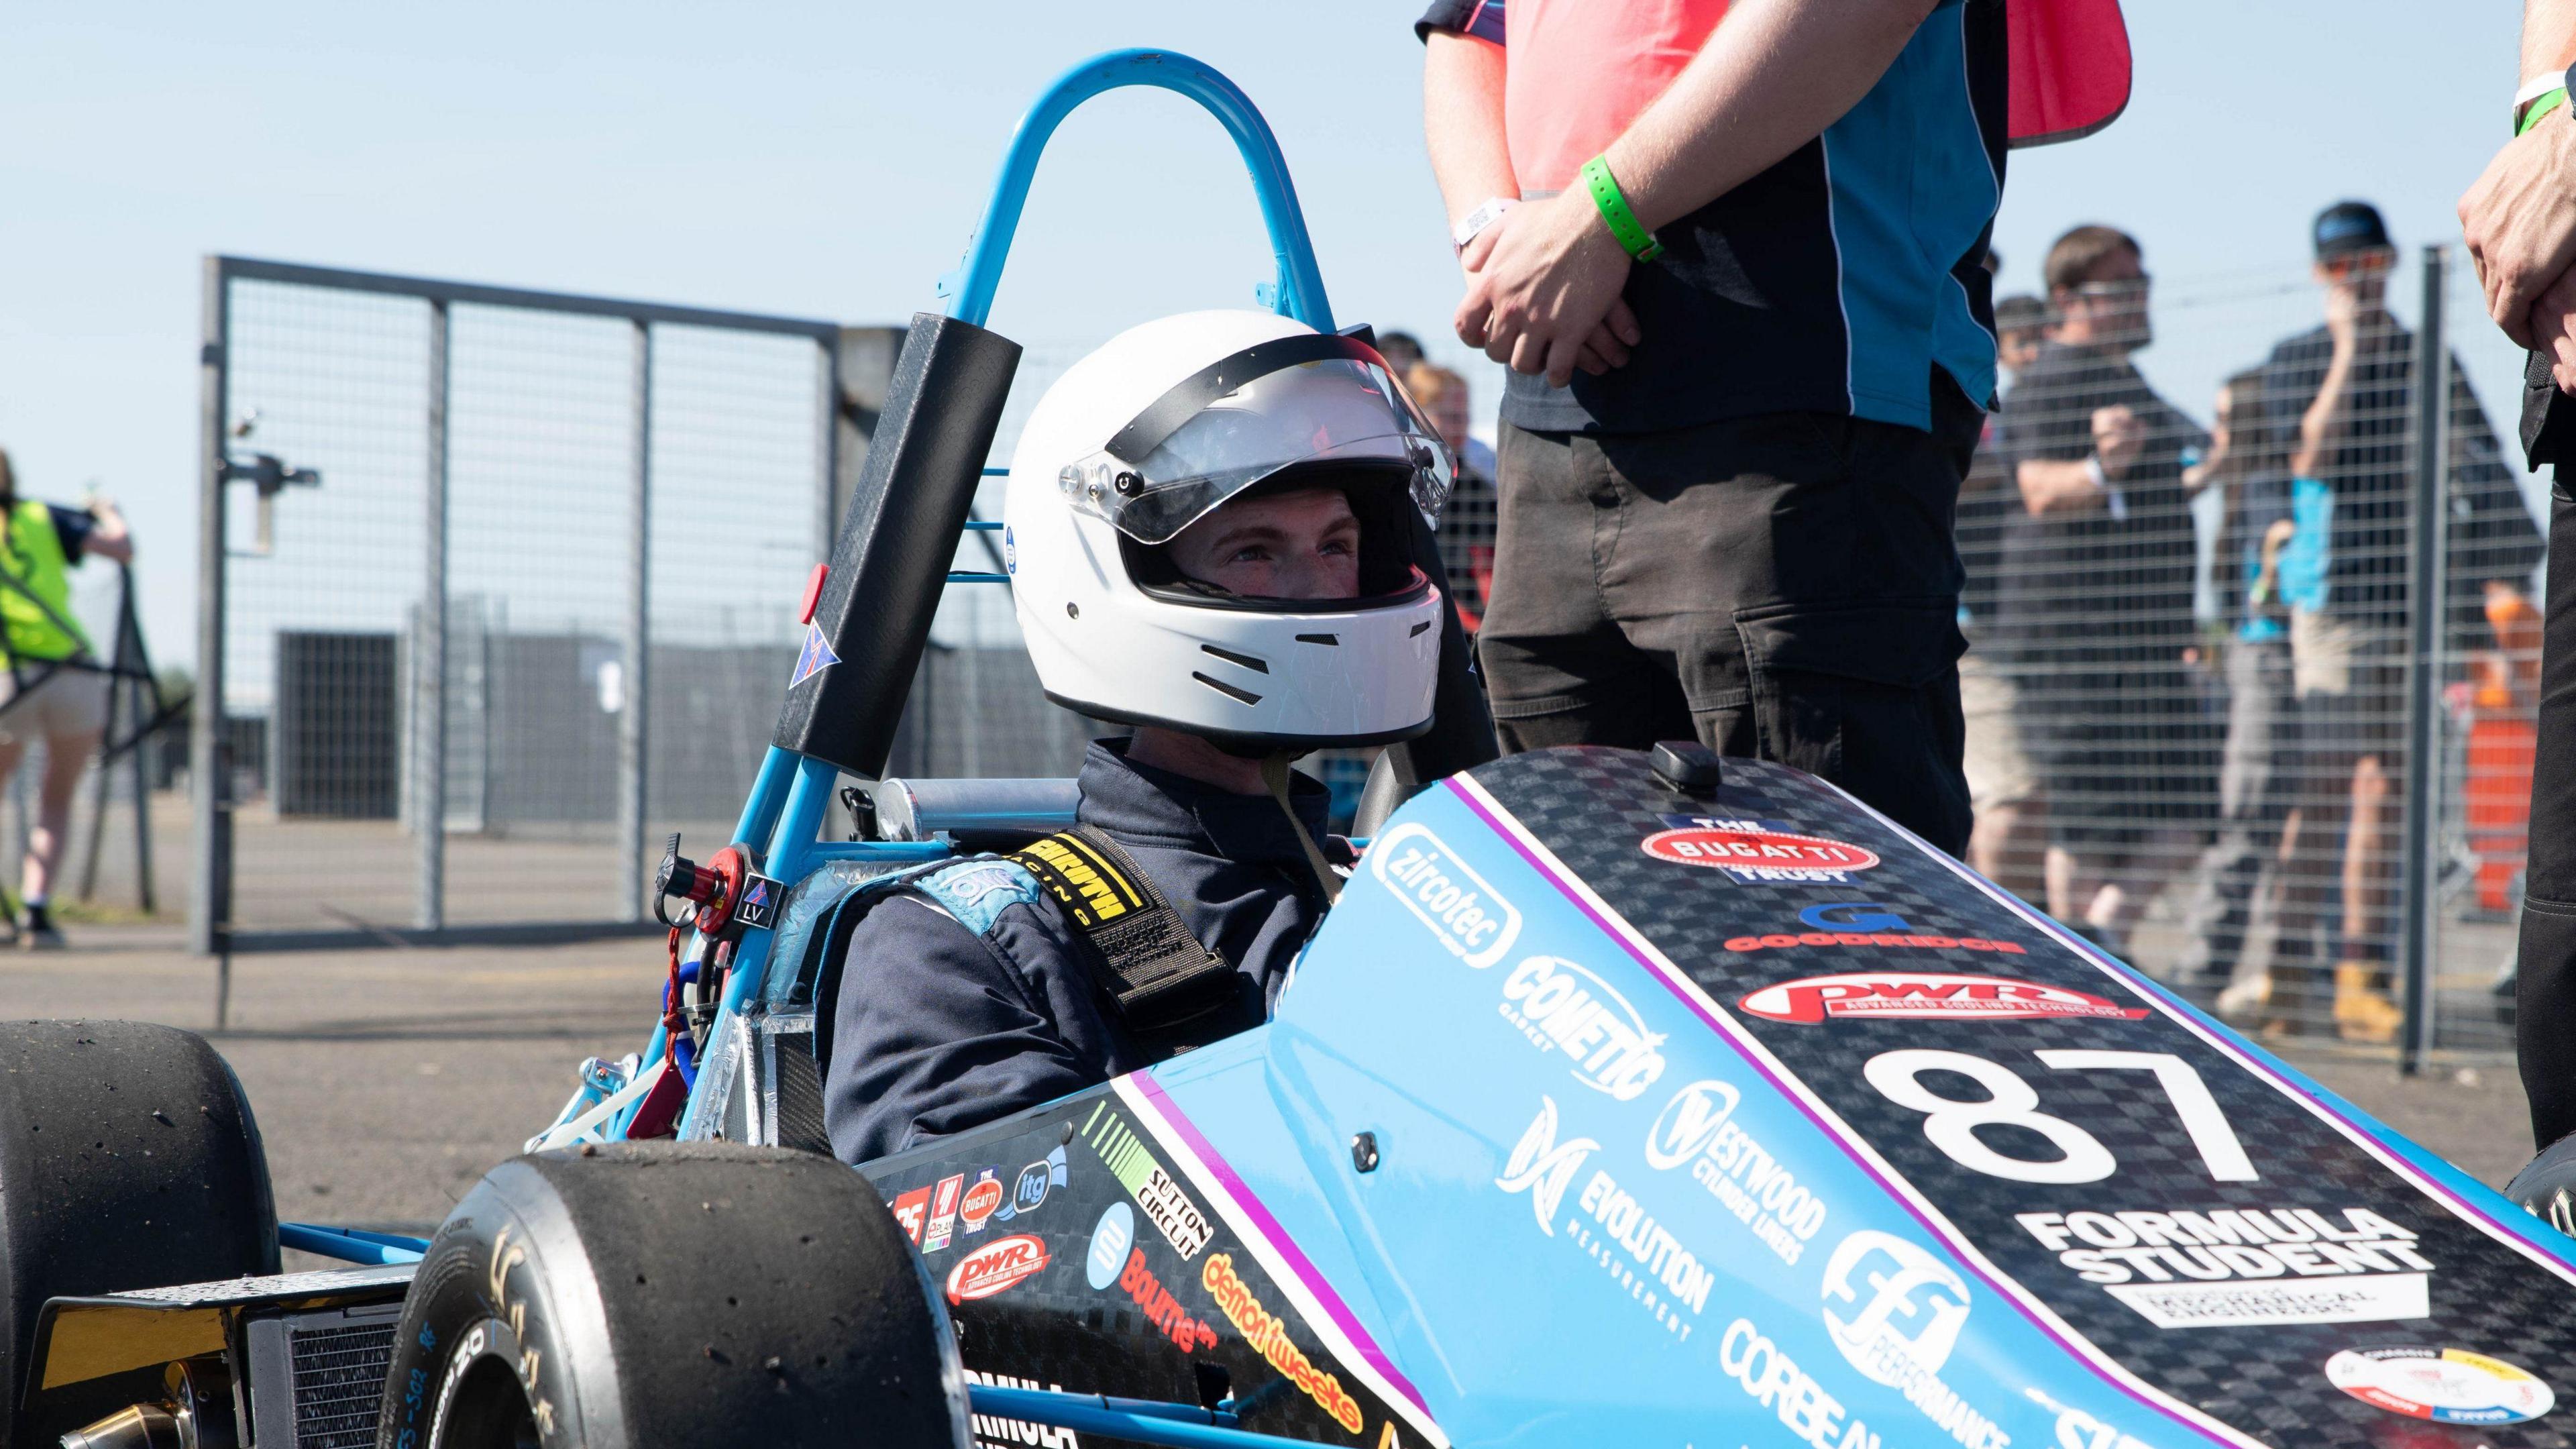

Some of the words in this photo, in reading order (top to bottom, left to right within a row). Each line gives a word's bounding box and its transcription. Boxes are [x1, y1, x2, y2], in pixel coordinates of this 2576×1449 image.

[1691, 818, 1768, 831] THE
[1670, 841, 1853, 862] BUGATTI
[1730, 867, 1849, 883] TRUST
[1018, 839, 1127, 920] CHROTH
[1389, 847, 1497, 947] zircotec
[743, 904, 764, 921] LV
[1503, 955, 1666, 1101] COMETIC
[1783, 983, 2053, 1025] PWR
[1845, 1002, 1937, 1011] ADVANCED
[1941, 1002, 2017, 1012] COOLING
[1864, 1049, 2259, 1184] 87
[980, 1169, 994, 1181] THE
[1657, 1085, 1827, 1240] WESTWOOD
[965, 1191, 998, 1214] BUGATTI
[1018, 1173, 1048, 1204] itg
[1148, 1169, 1211, 1244] SUTTON
[1692, 1157, 1759, 1225] CYLINDER
[965, 1219, 987, 1234] TRUST
[1138, 1187, 1197, 1257] CIRCUIT
[1578, 1169, 1715, 1316] EVOLUTION
[2015, 1208, 2419, 1251] FORMULA
[954, 1243, 1031, 1295] PWR
[968, 1276, 992, 1289] ADVANCED
[992, 1271, 1012, 1284] COOLING
[1012, 1261, 1043, 1277] TECHNOLOGY
[1566, 1218, 1693, 1342] MEASUREMENT
[2059, 1240, 2436, 1284] STUDENT
[1120, 1246, 1196, 1354] Bourne
[1720, 1318, 1882, 1449] CORBEA
